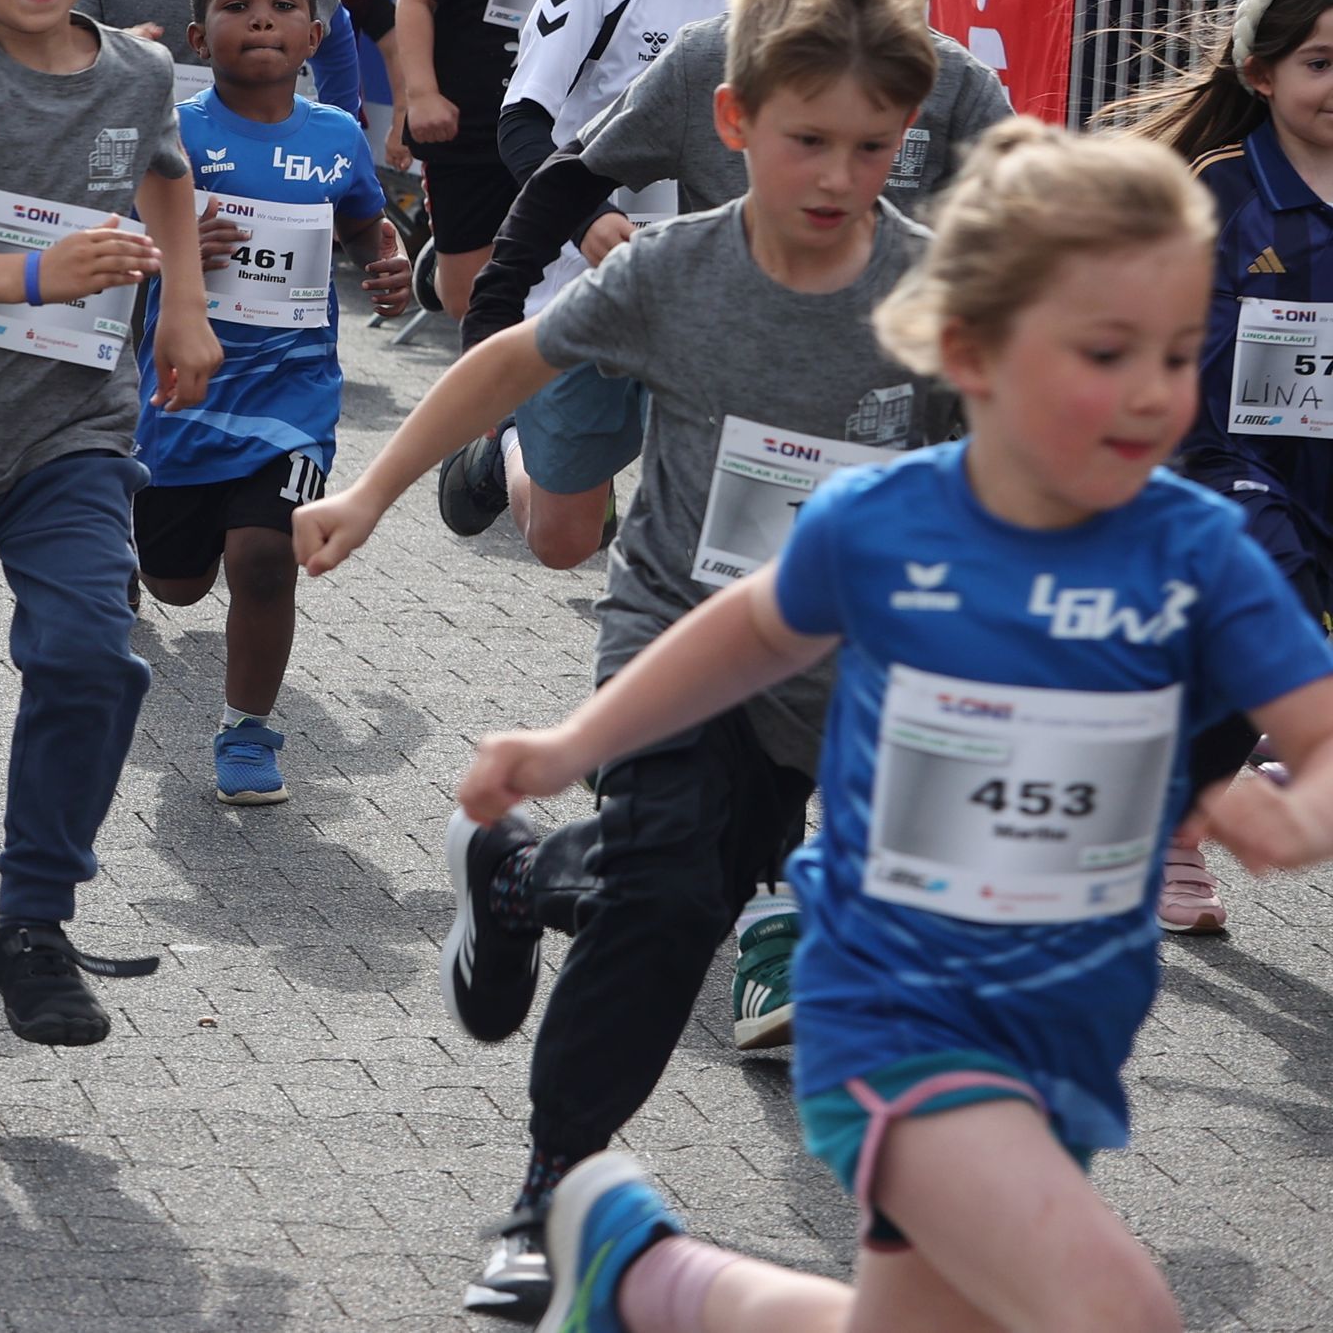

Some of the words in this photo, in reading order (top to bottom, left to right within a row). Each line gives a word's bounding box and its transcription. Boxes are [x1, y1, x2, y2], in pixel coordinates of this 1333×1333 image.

[200, 161, 235, 174] erima
[272, 146, 333, 184] LGW
[26, 207, 61, 226] ONI
[226, 203, 255, 217] ONI
[20, 235, 52, 248] LÄUFT
[230, 245, 295, 271] 461
[237, 269, 287, 284] Ibrahima
[293, 308, 305, 322] SC
[1285, 309, 1317, 323] ONI
[1241, 331, 1282, 342] LINDLAR
[1283, 334, 1313, 343] LÄUFT
[97, 344, 113, 361] SC
[1234, 414, 1271, 426] LANG
[779, 441, 822, 463] ONI
[722, 459, 772, 479] LINDLAR
[773, 472, 812, 487] LÄUFT
[968, 778, 1098, 818] 453
